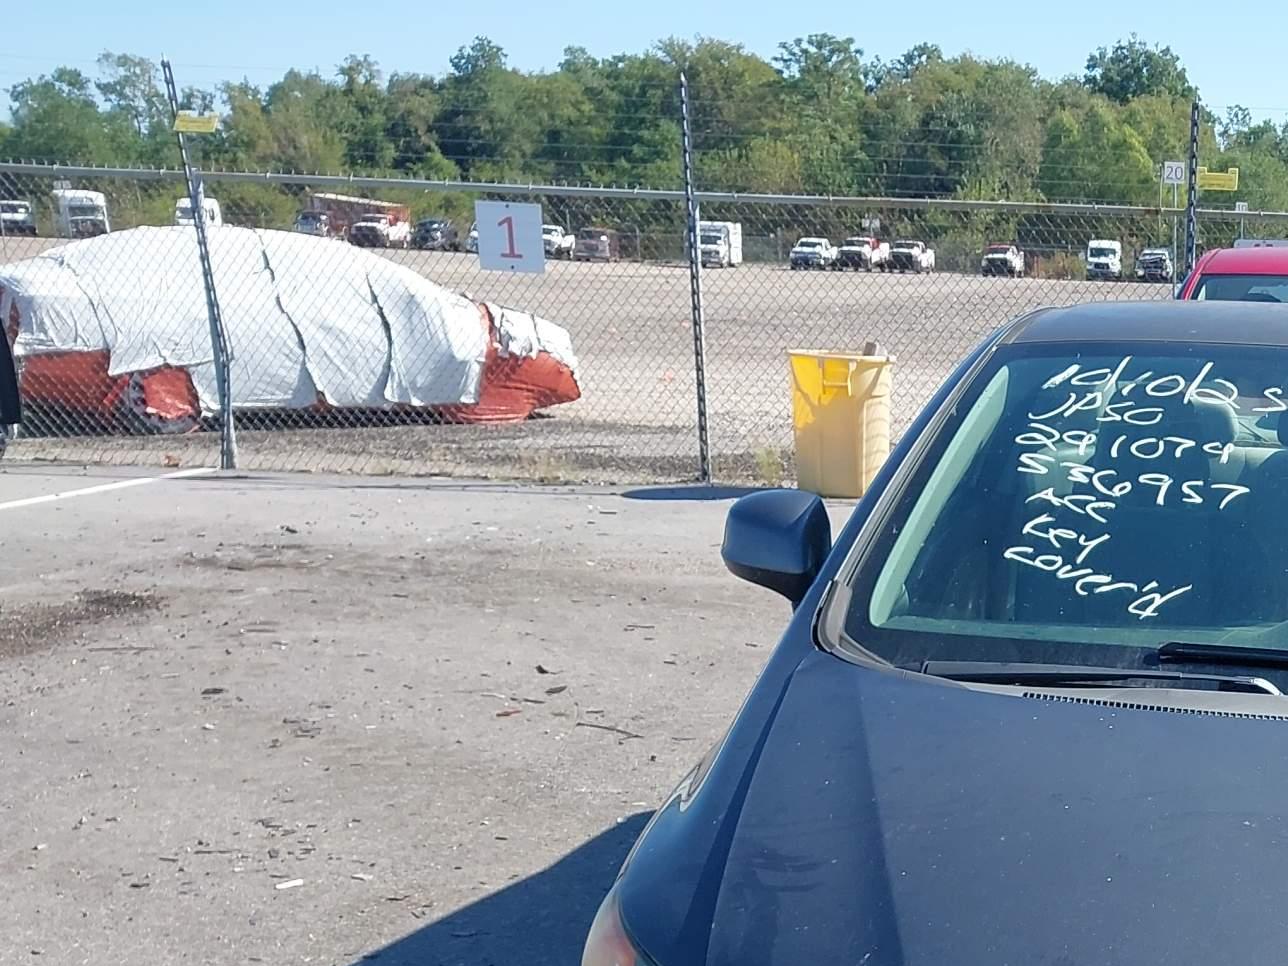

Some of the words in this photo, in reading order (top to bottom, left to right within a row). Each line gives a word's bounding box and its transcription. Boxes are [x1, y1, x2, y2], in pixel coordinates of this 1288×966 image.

[1166, 166, 1184, 180] 20
[498, 216, 523, 259] 1
[1022, 513, 1111, 564] Key
